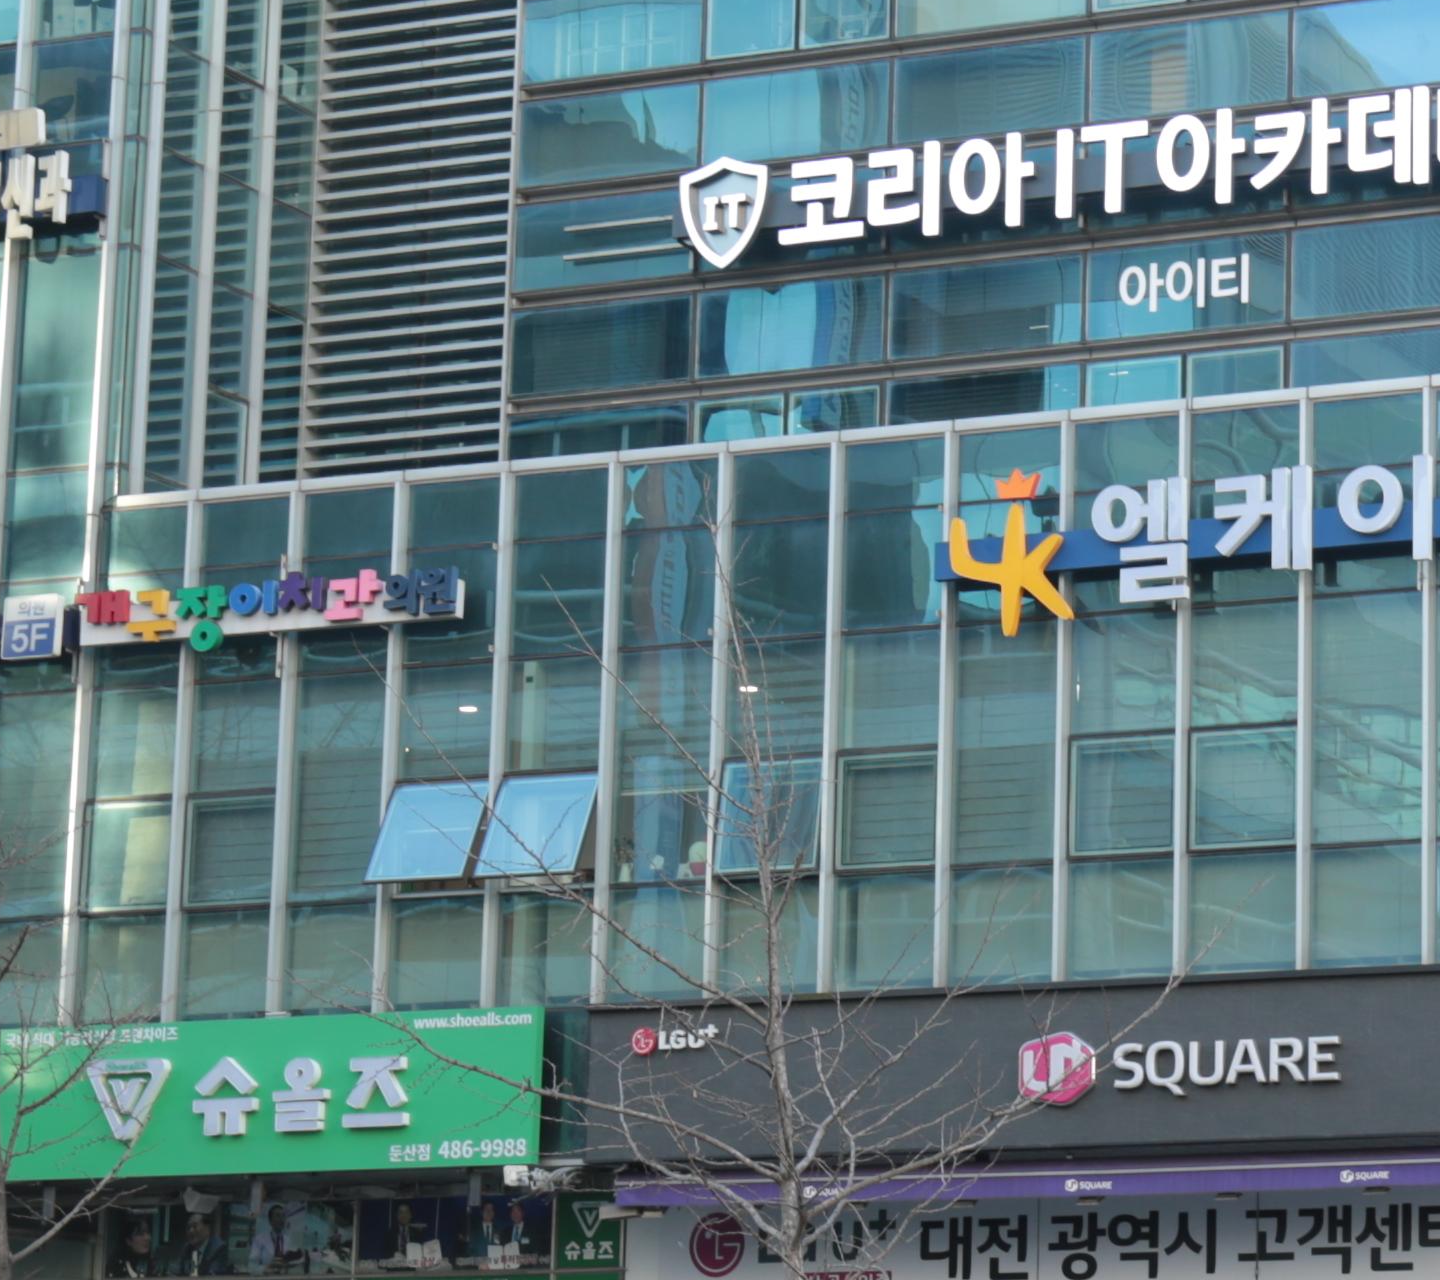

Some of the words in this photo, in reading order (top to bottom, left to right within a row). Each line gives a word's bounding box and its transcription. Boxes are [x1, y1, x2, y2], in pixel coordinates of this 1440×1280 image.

[703, 191, 748, 234] IT
[1119, 254, 1250, 313] 아이티
[10, 622, 49, 656] 5F
[413, 1011, 533, 1030] www.shoealls.com
[1113, 1035, 1340, 1095] SQUARE
[192, 1055, 410, 1137] 슈올즈
[389, 1142, 431, 1162] 둔산점
[438, 1138, 526, 1161] 486-9988
[565, 1241, 614, 1261] 슈올즈
[921, 1209, 1030, 1280] 대전
[1049, 1208, 1219, 1280] 광역시
